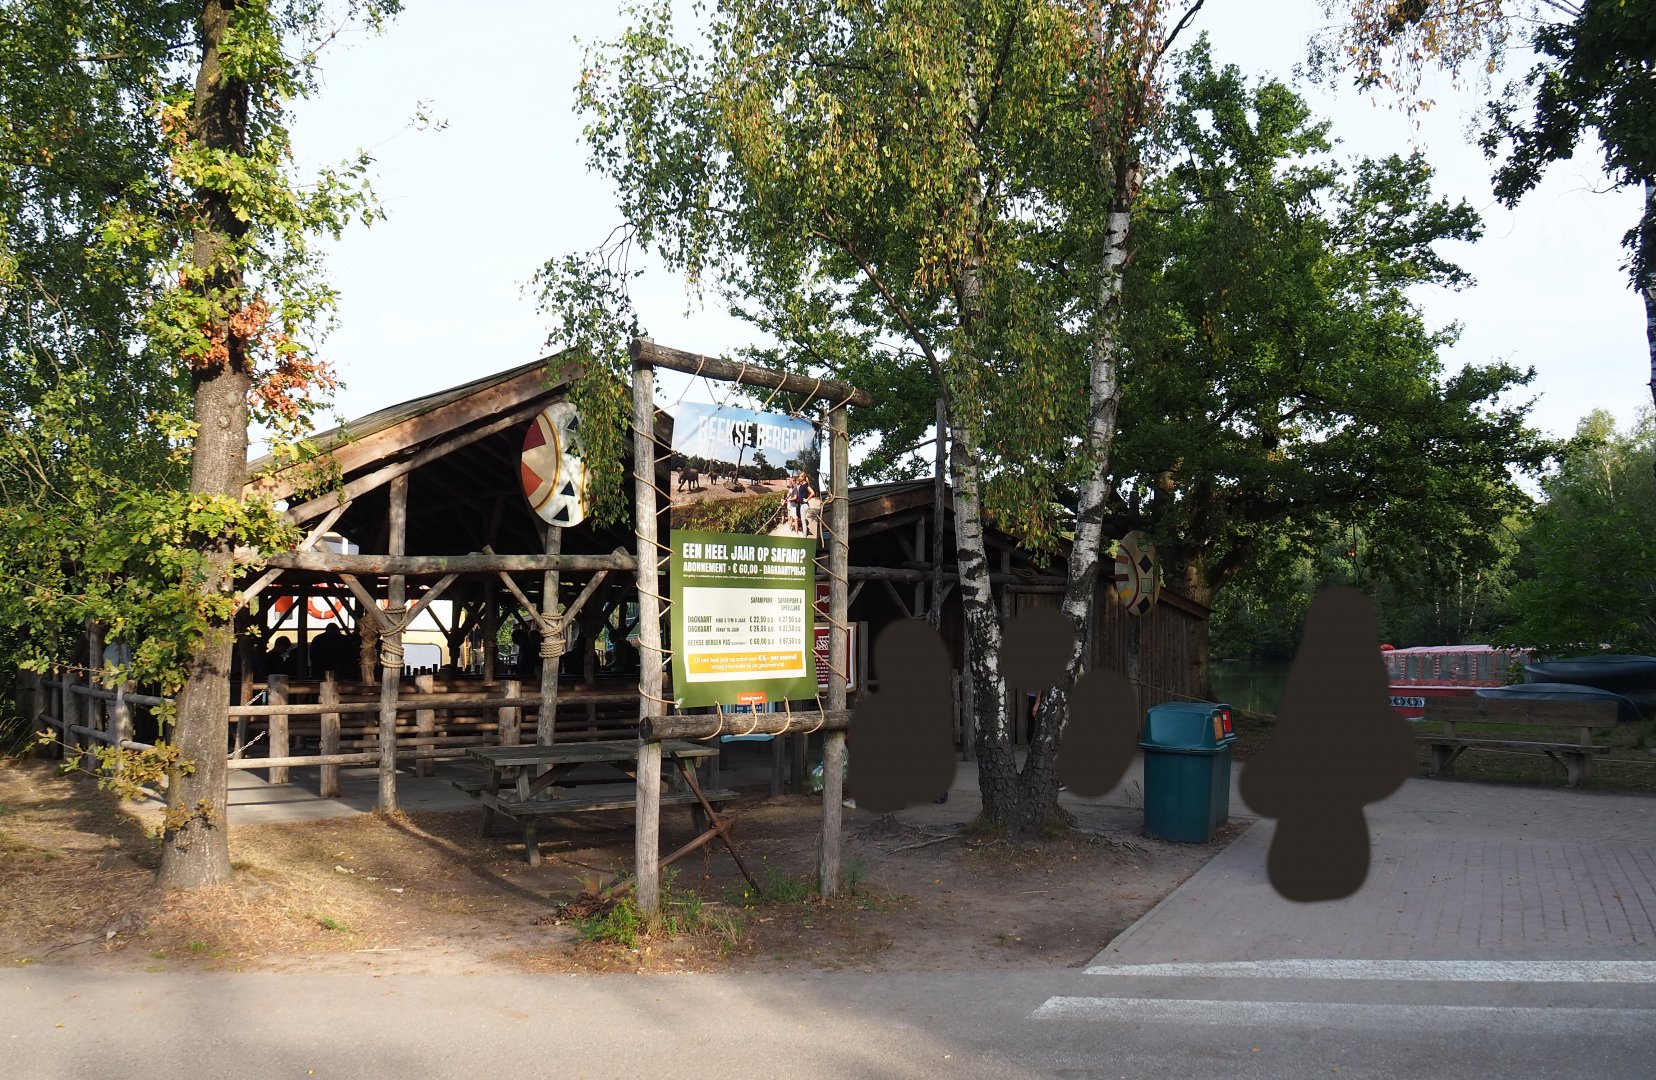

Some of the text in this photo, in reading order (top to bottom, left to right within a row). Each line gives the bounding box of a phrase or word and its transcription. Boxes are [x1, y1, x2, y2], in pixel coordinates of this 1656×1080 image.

[698, 415, 805, 454] BEEKSE BERGEN
[683, 543, 806, 563] EEN HEEL JAAR OP SAFARI?
[683, 561, 726, 572] ABONNEMENT
[733, 563, 737, 573] €
[739, 564, 758, 575] 60,00
[763, 565, 806, 576] DAGKAARTPRIJS
